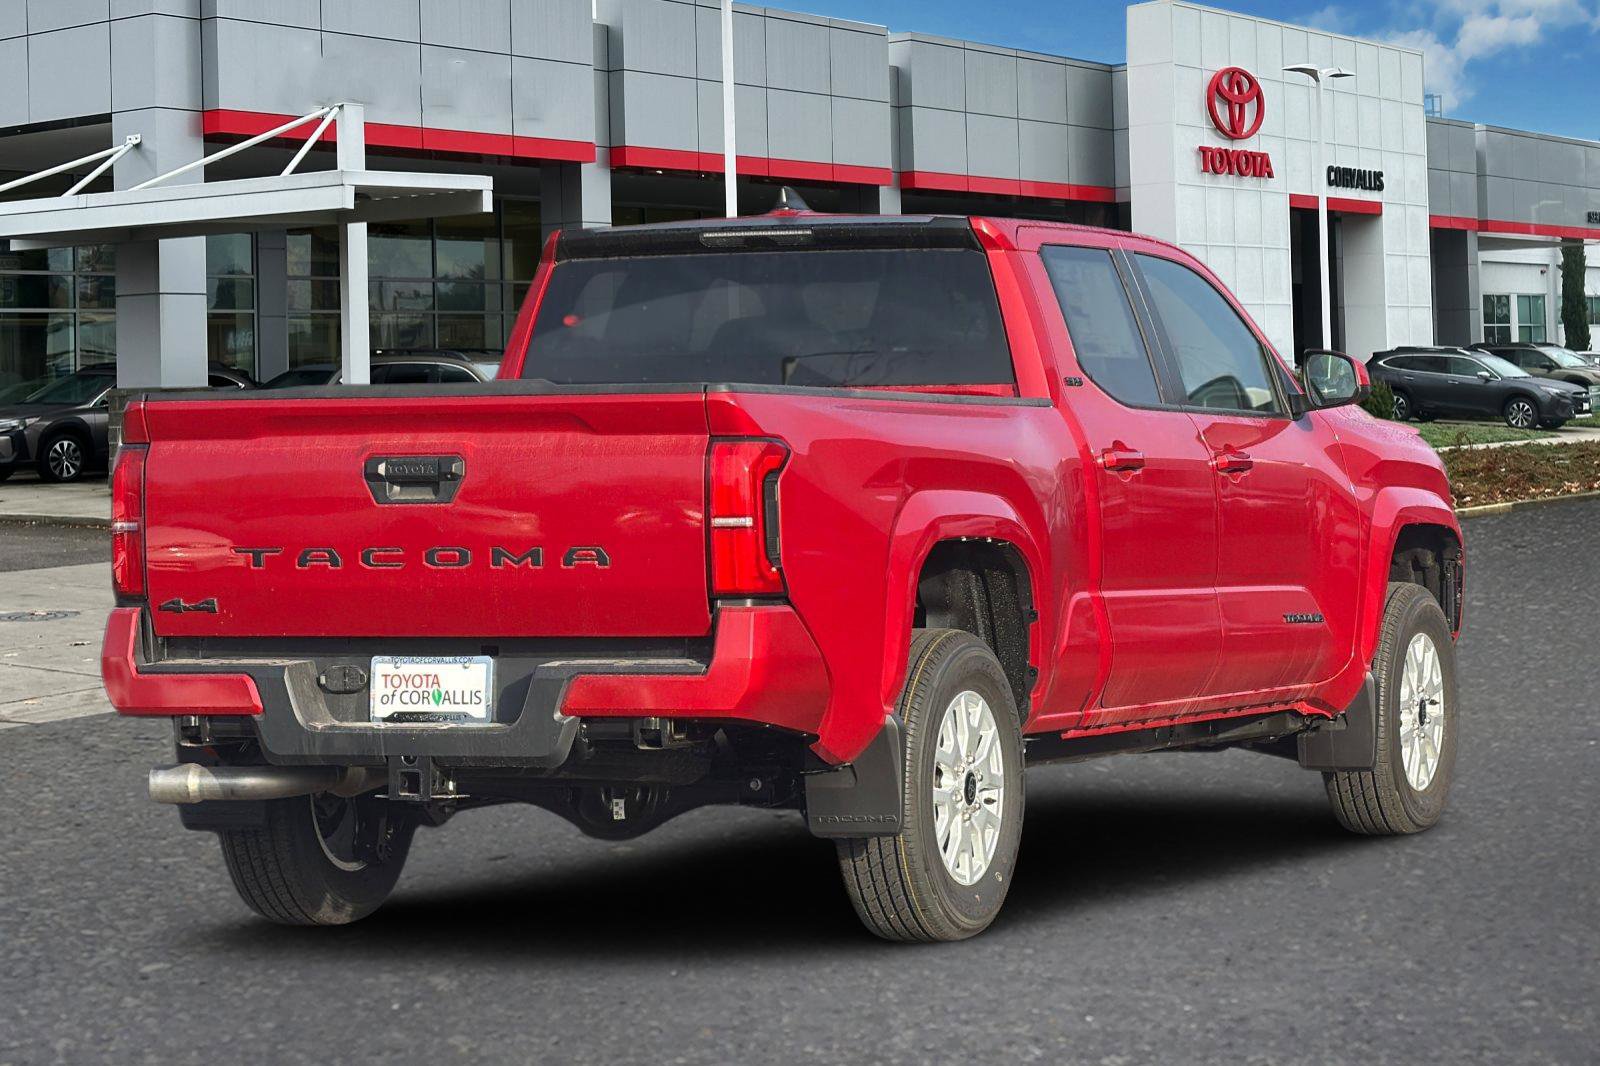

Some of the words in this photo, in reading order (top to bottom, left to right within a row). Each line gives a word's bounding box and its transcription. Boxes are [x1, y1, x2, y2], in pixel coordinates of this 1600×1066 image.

[1199, 146, 1274, 178] TOYOTA
[1326, 165, 1385, 191] CORVALLIS
[388, 463, 434, 475] TOYOTA
[233, 546, 611, 569] TACOMA
[381, 673, 441, 689] TOYOTA
[380, 689, 397, 705] of
